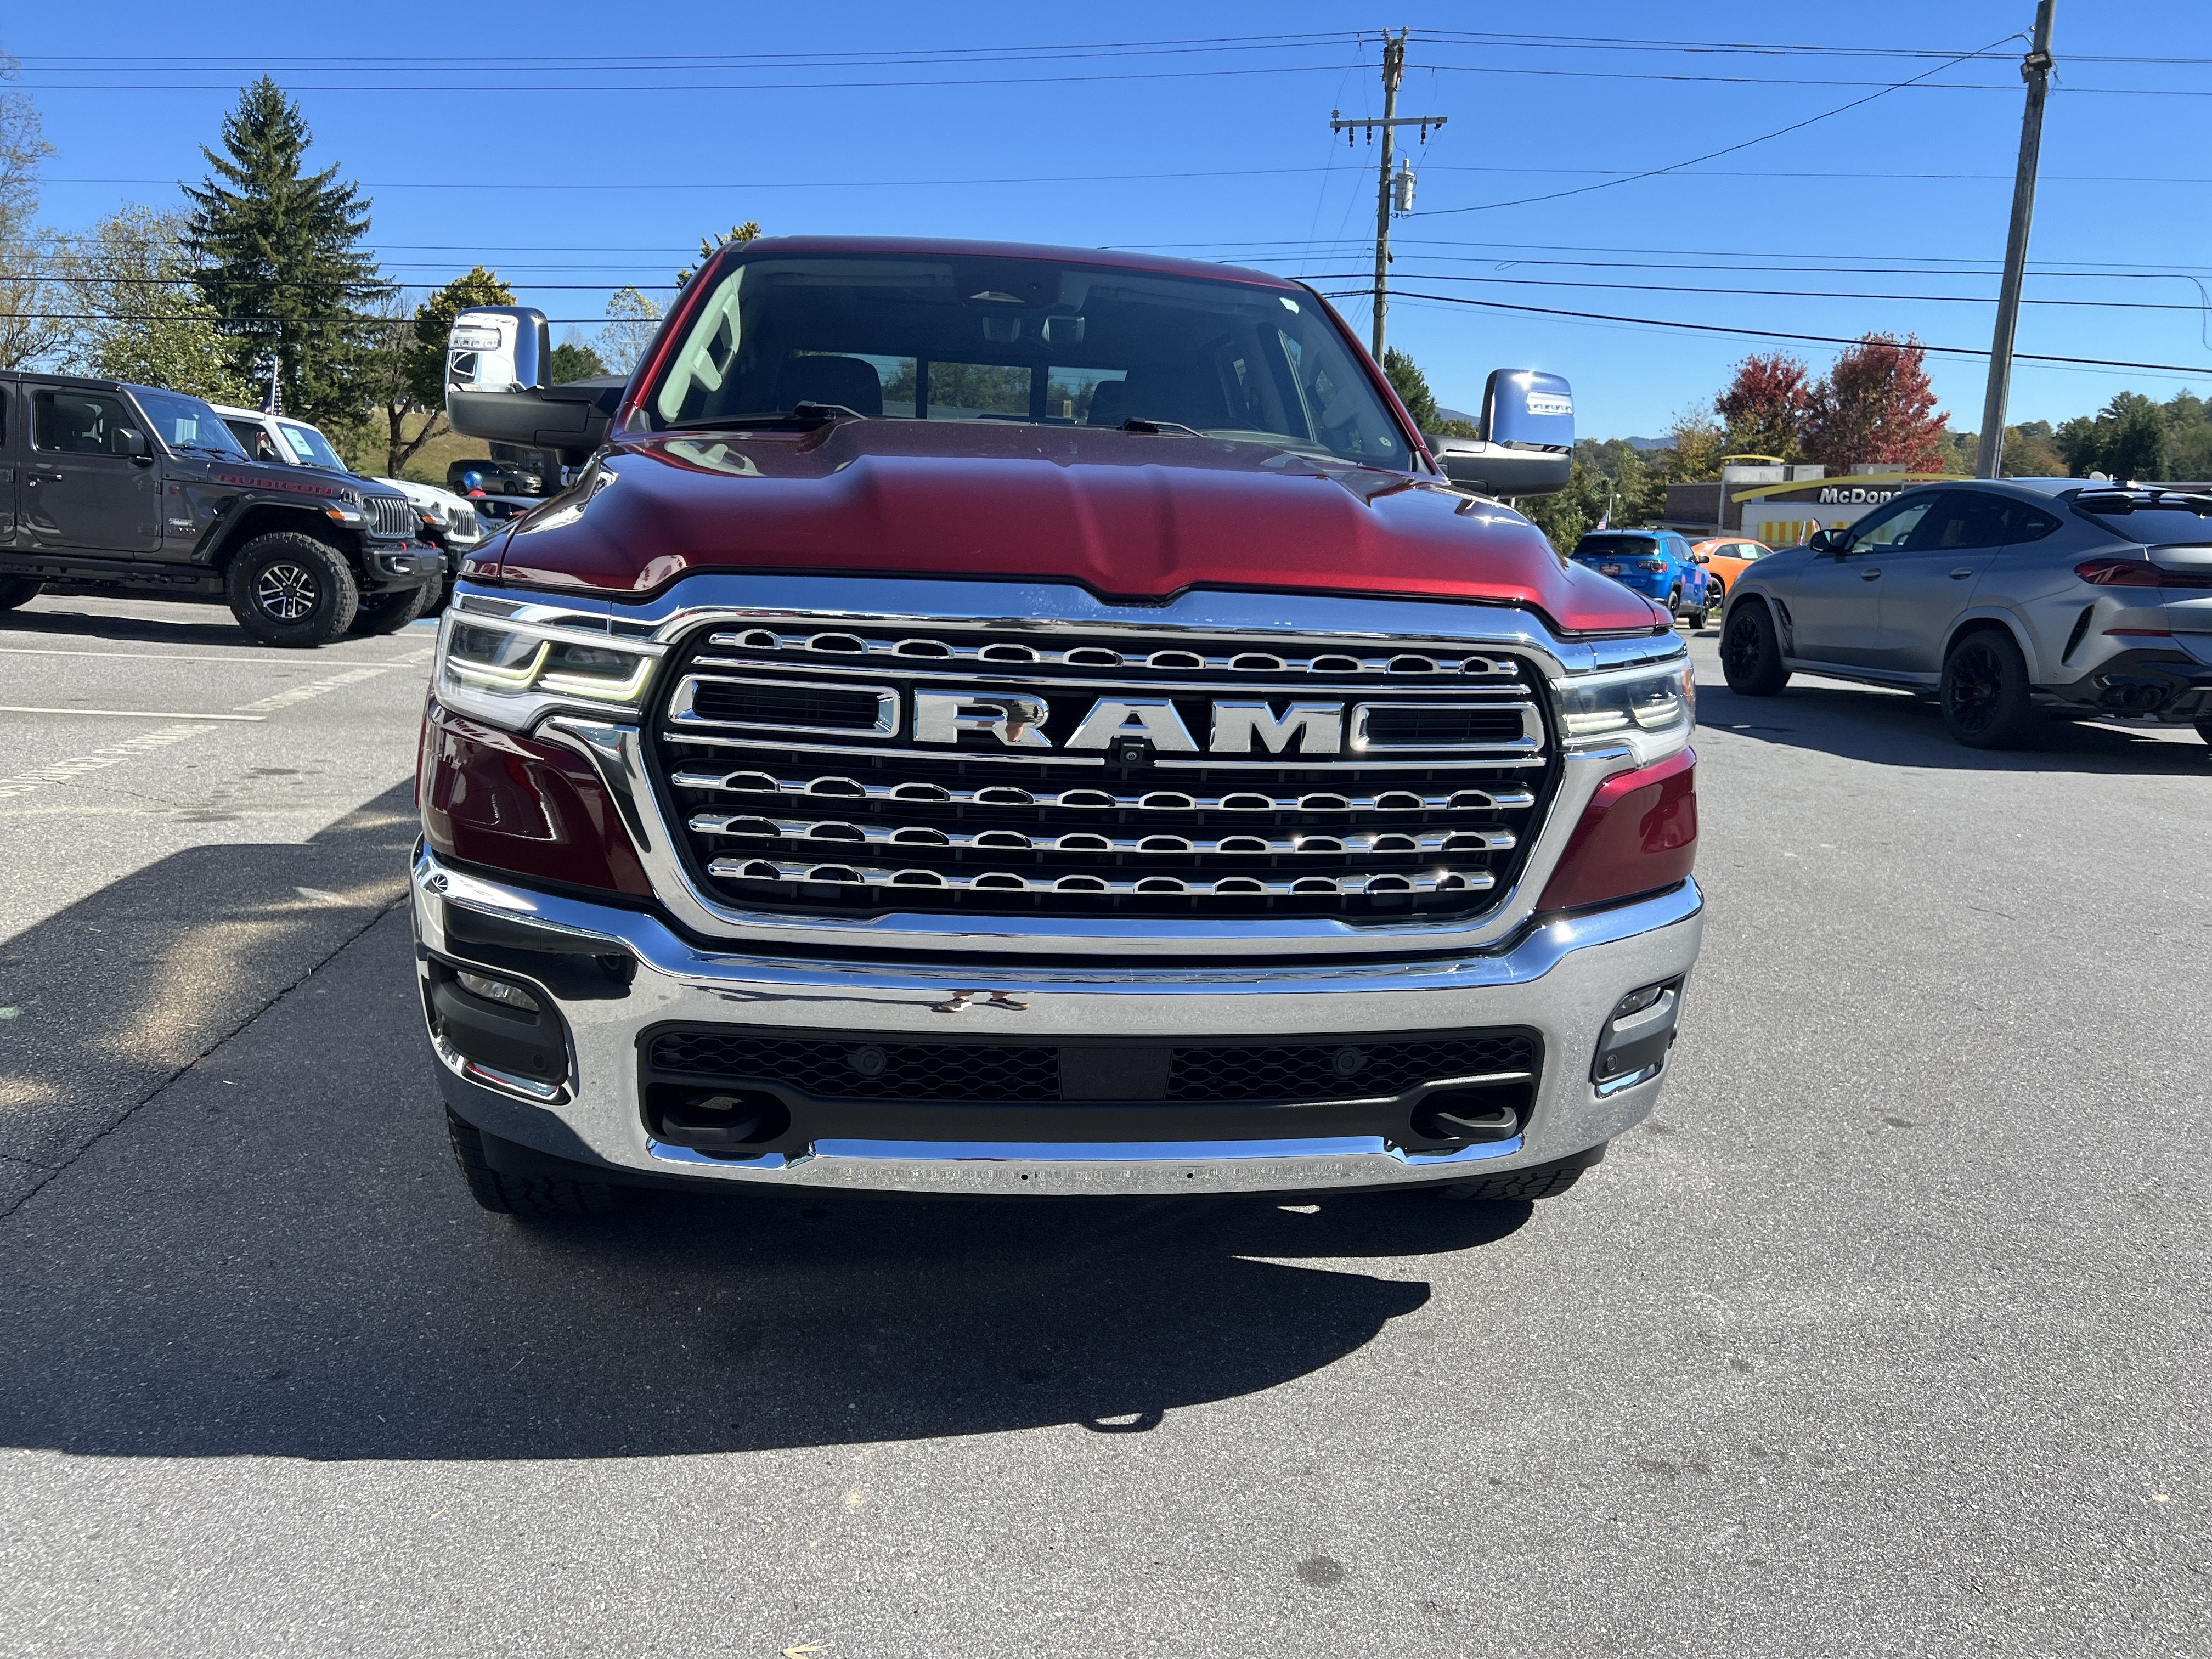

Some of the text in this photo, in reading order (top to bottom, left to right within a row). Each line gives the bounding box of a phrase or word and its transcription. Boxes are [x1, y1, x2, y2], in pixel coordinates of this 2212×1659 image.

[219, 474, 333, 495] RUBICON
[1819, 488, 1902, 504] McDon
[913, 688, 1346, 754] RAM
